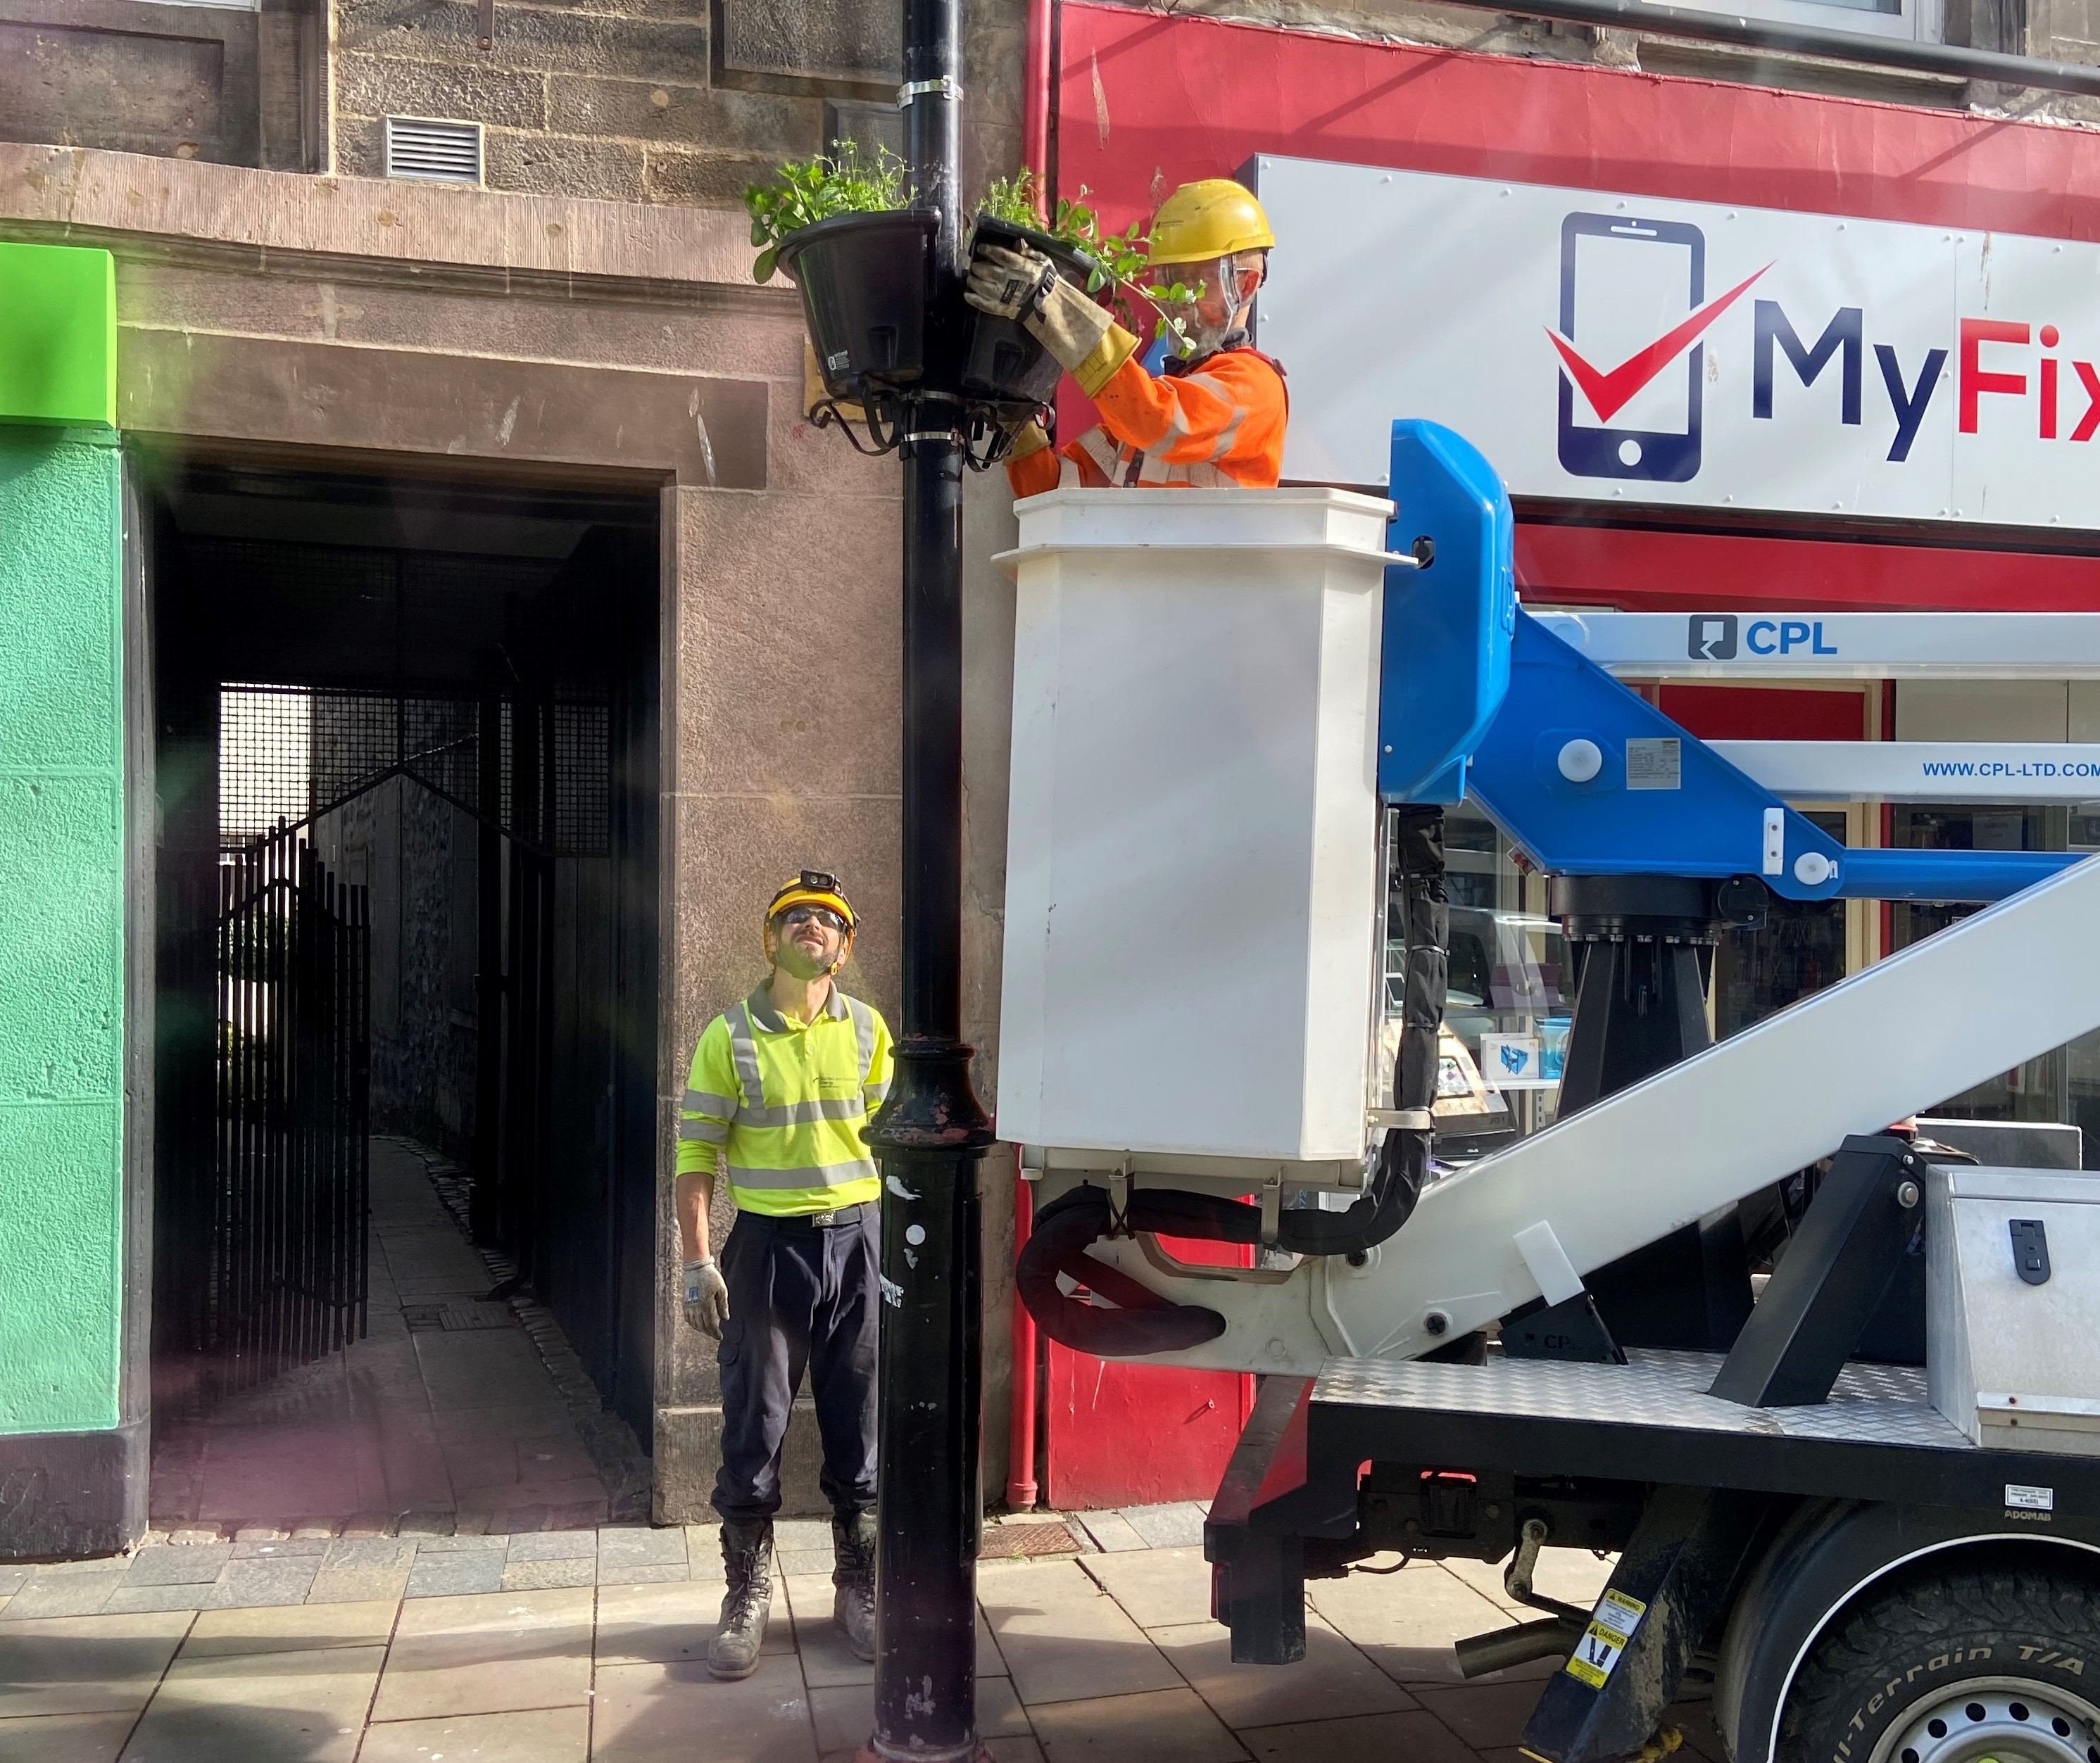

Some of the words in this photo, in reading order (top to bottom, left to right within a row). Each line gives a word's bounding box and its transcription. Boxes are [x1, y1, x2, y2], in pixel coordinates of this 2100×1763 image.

[1747, 621, 1838, 655] CPL
[1923, 762, 2100, 777] WWW.CPL-LTD.COM
[1617, 1595, 1640, 1611] WARNING
[1598, 1628, 1626, 1646] DANGER
[2018, 1645, 2085, 1676] T/A
